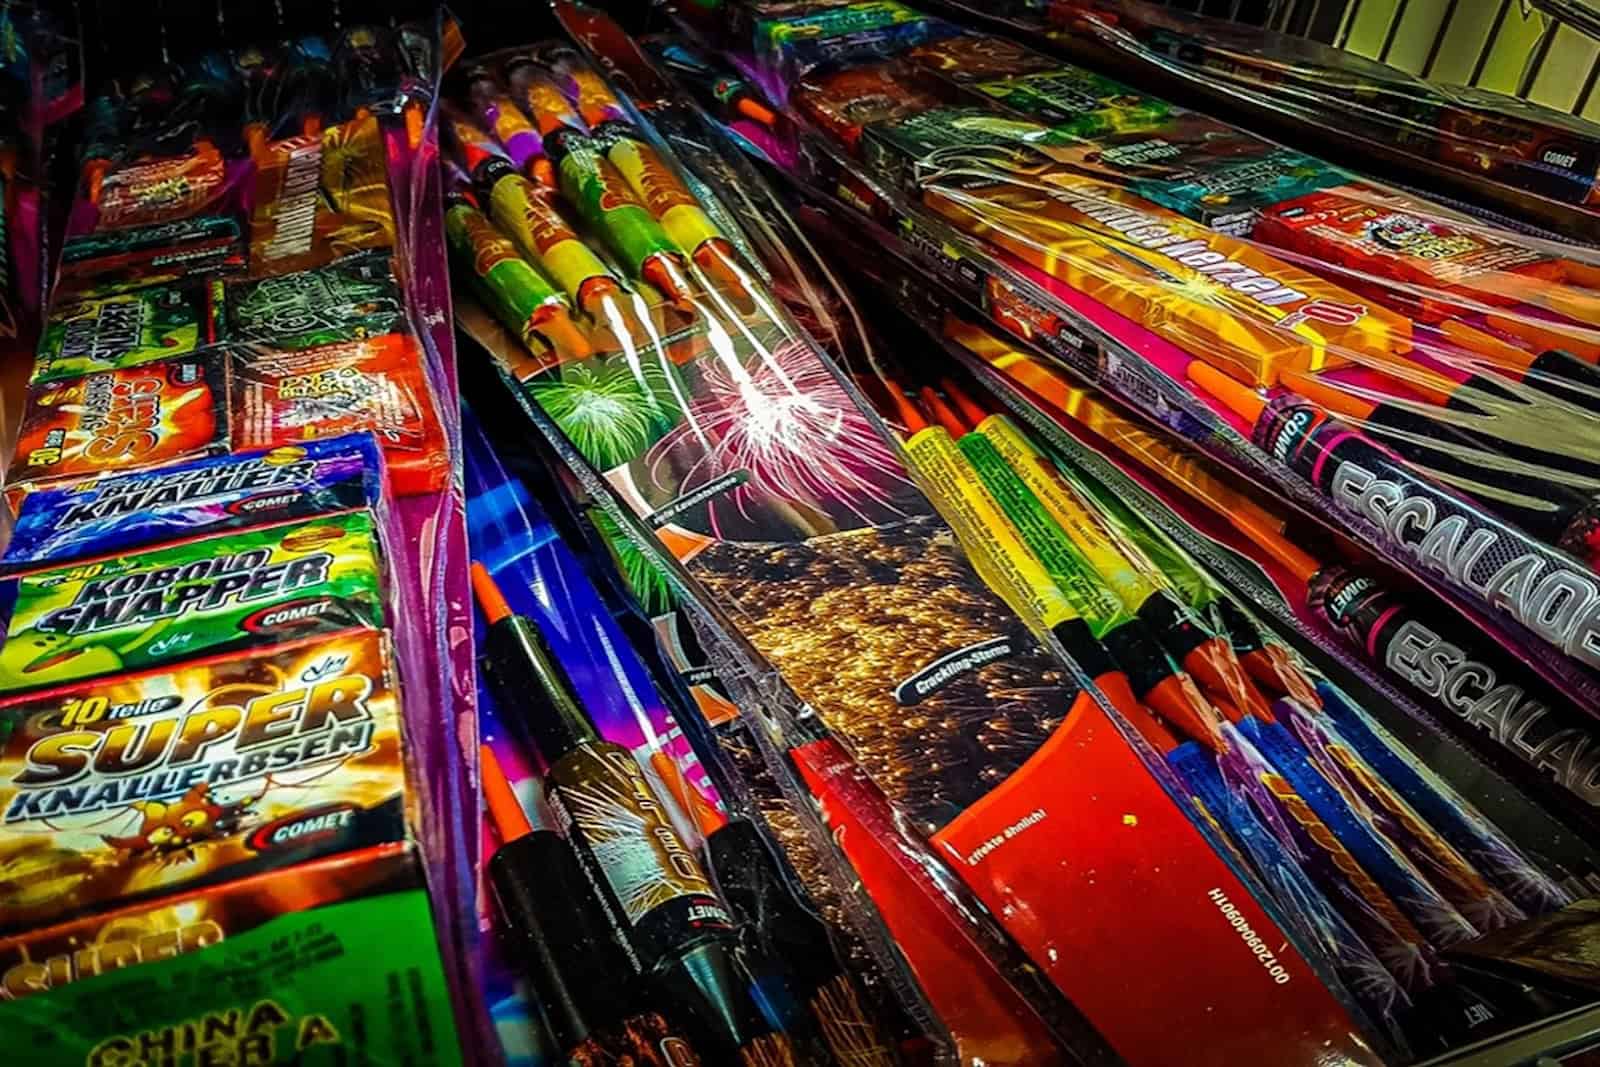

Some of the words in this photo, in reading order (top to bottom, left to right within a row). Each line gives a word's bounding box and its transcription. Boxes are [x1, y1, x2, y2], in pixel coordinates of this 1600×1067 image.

[28, 440, 61, 466] 50
[56, 459, 317, 530] KNALLER
[242, 493, 303, 511] COMET
[37, 553, 334, 635] SNAPPER
[68, 564, 102, 582] 50
[73, 547, 272, 608] KOBOLD
[263, 602, 333, 628] COMET
[12, 674, 374, 785] SUPER
[61, 696, 105, 727] 10
[108, 698, 167, 720] Teile
[1385, 619, 1600, 805] ESCALA
[5, 721, 373, 823] KNALLERBSEN
[272, 809, 355, 843] COMET
